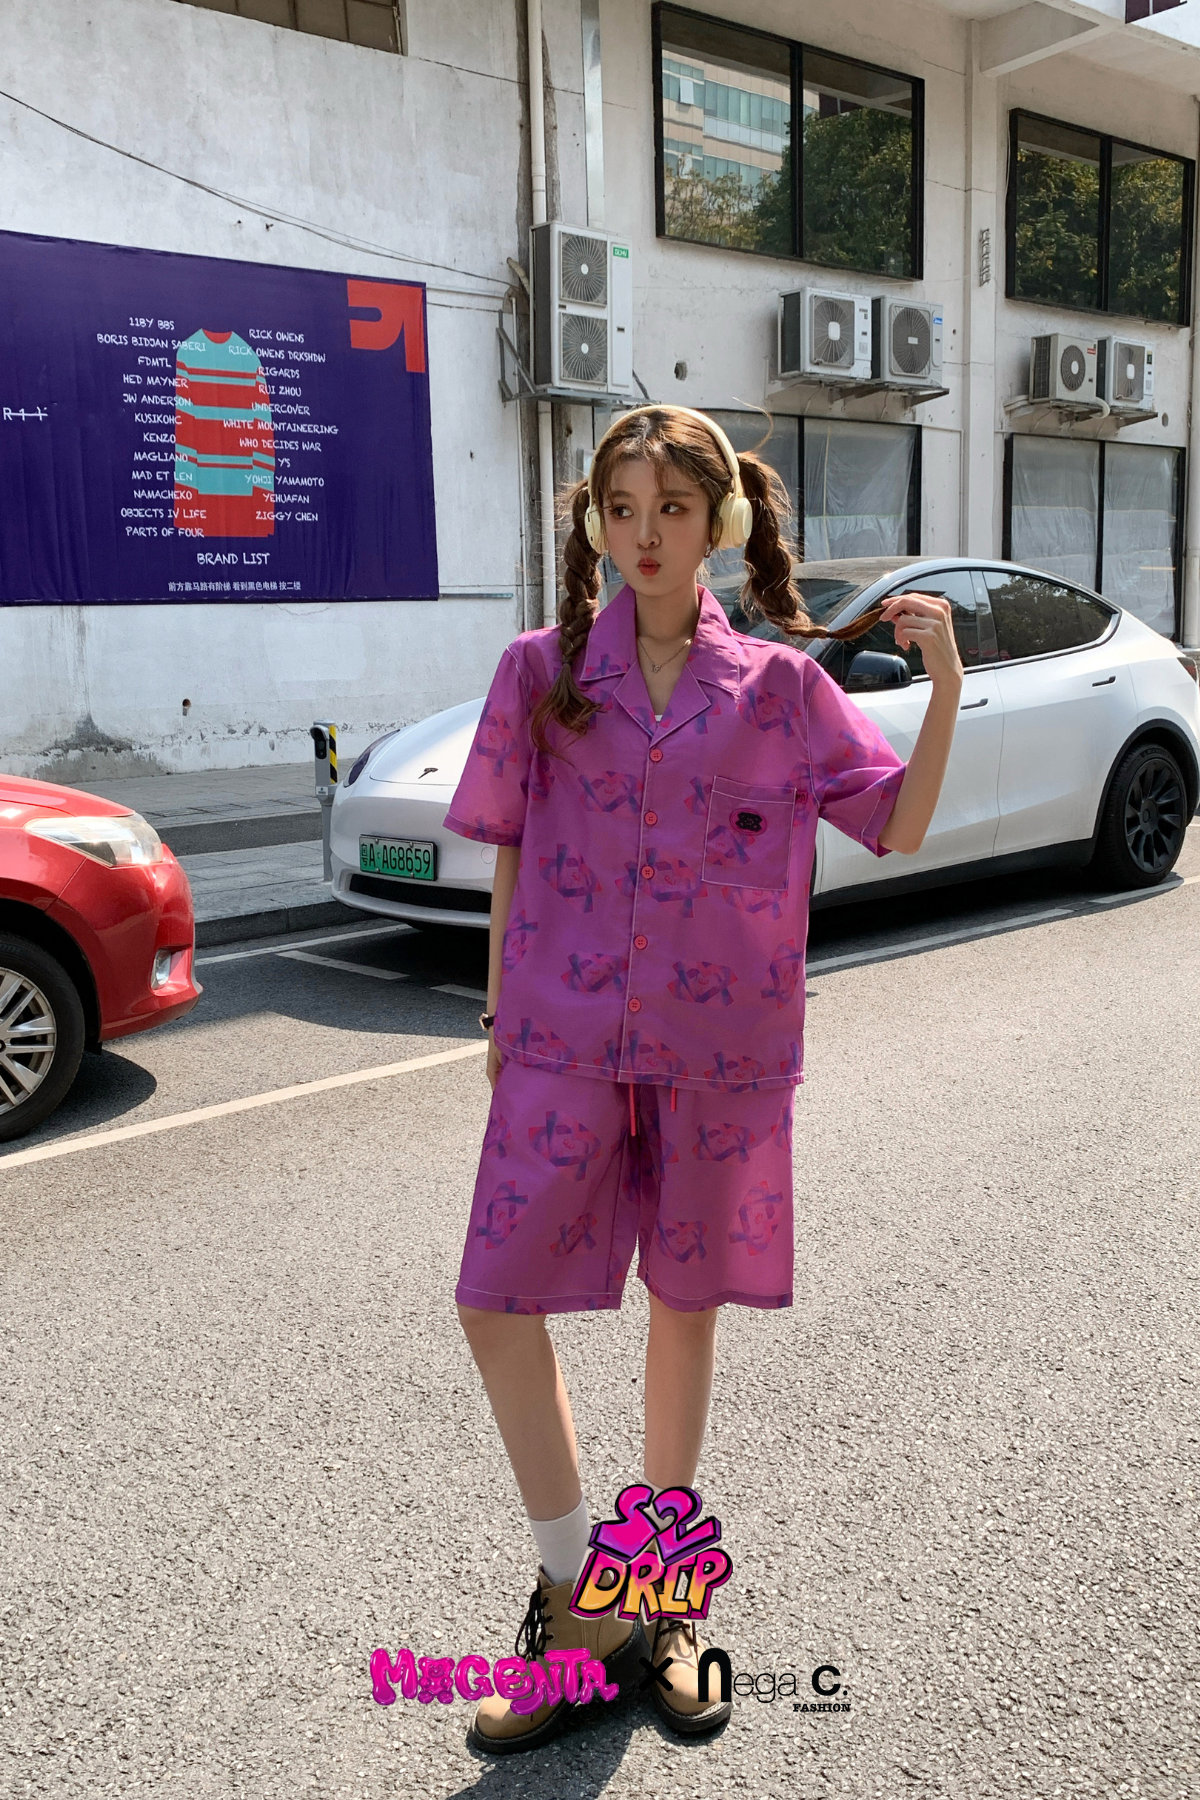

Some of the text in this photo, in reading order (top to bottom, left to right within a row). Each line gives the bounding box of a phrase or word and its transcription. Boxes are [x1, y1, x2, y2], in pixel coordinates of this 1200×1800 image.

[129, 317, 175, 330] 11BY BBS
[97, 333, 206, 352] BORIS BIDJAN SABERI
[249, 329, 305, 343] RICK OWENS
[229, 346, 326, 363] RICK OWENS DRKSHDW
[138, 356, 172, 367] FDMTL
[258, 366, 300, 379] RIGARDS
[123, 374, 189, 388] HED MAYNER
[259, 385, 302, 397] RUI ZHOU
[123, 393, 192, 407] JW ANDERSON
[252, 402, 311, 416] UNDERCOVER
[135, 413, 183, 425] KUSIKOHC
[223, 418, 339, 435] WHITE MOUNTAINEERING
[143, 432, 176, 444] KENZO
[239, 438, 322, 452] WHO DECIDES WAR
[134, 452, 188, 462] MAGLIANO
[132, 470, 193, 481] MAD ET LEN
[244, 474, 325, 487] YOHJI YAMAMOTO
[133, 489, 193, 501] NAMACHEKO
[262, 492, 310, 504] YEHUAFAN
[120, 507, 207, 519] OBJECTS IV LIFE
[255, 511, 319, 522] ZIGGY CHEN
[125, 526, 205, 538] PARTS OF FOUR
[196, 552, 271, 566] BRAND LIST
